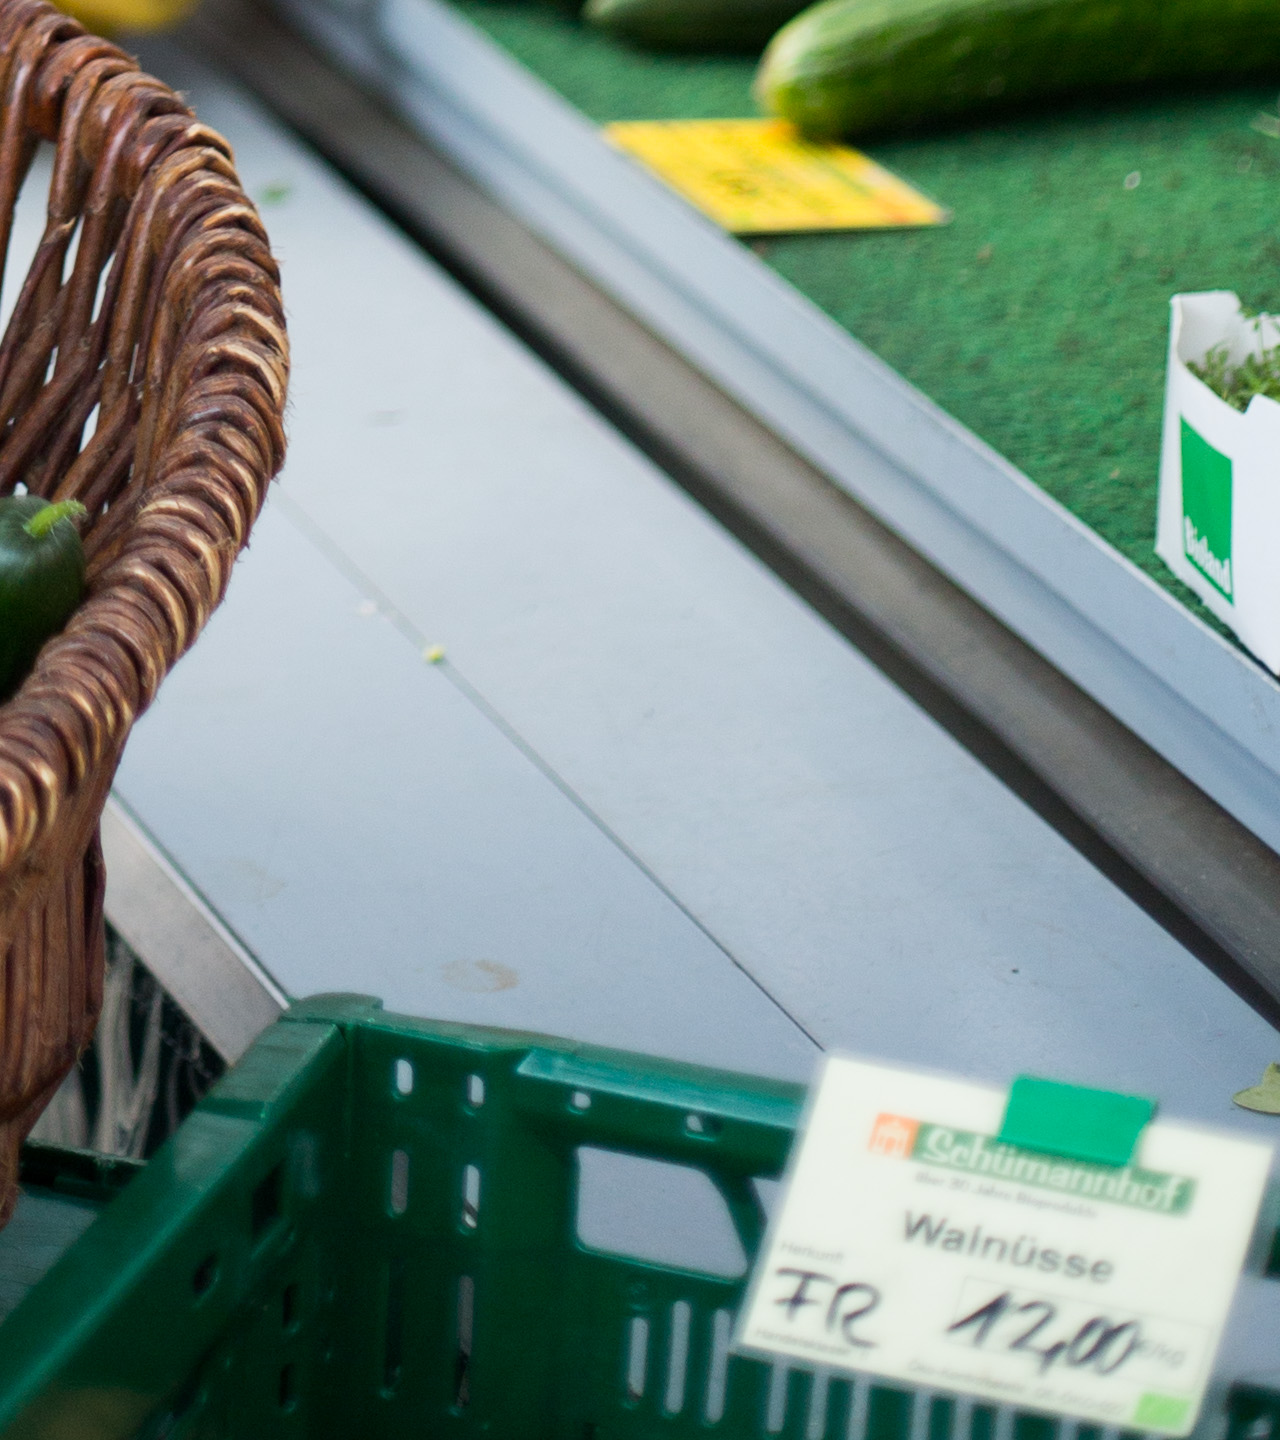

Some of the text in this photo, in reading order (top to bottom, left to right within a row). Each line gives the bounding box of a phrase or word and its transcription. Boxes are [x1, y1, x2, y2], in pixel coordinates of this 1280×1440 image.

[1184, 514, 1232, 596] Bioland
[925, 1122, 1182, 1209] Schümannhof
[903, 1208, 1114, 1283] Walnüsse
[774, 1267, 880, 1349] FR
[945, 1291, 1140, 1376] 12,00
